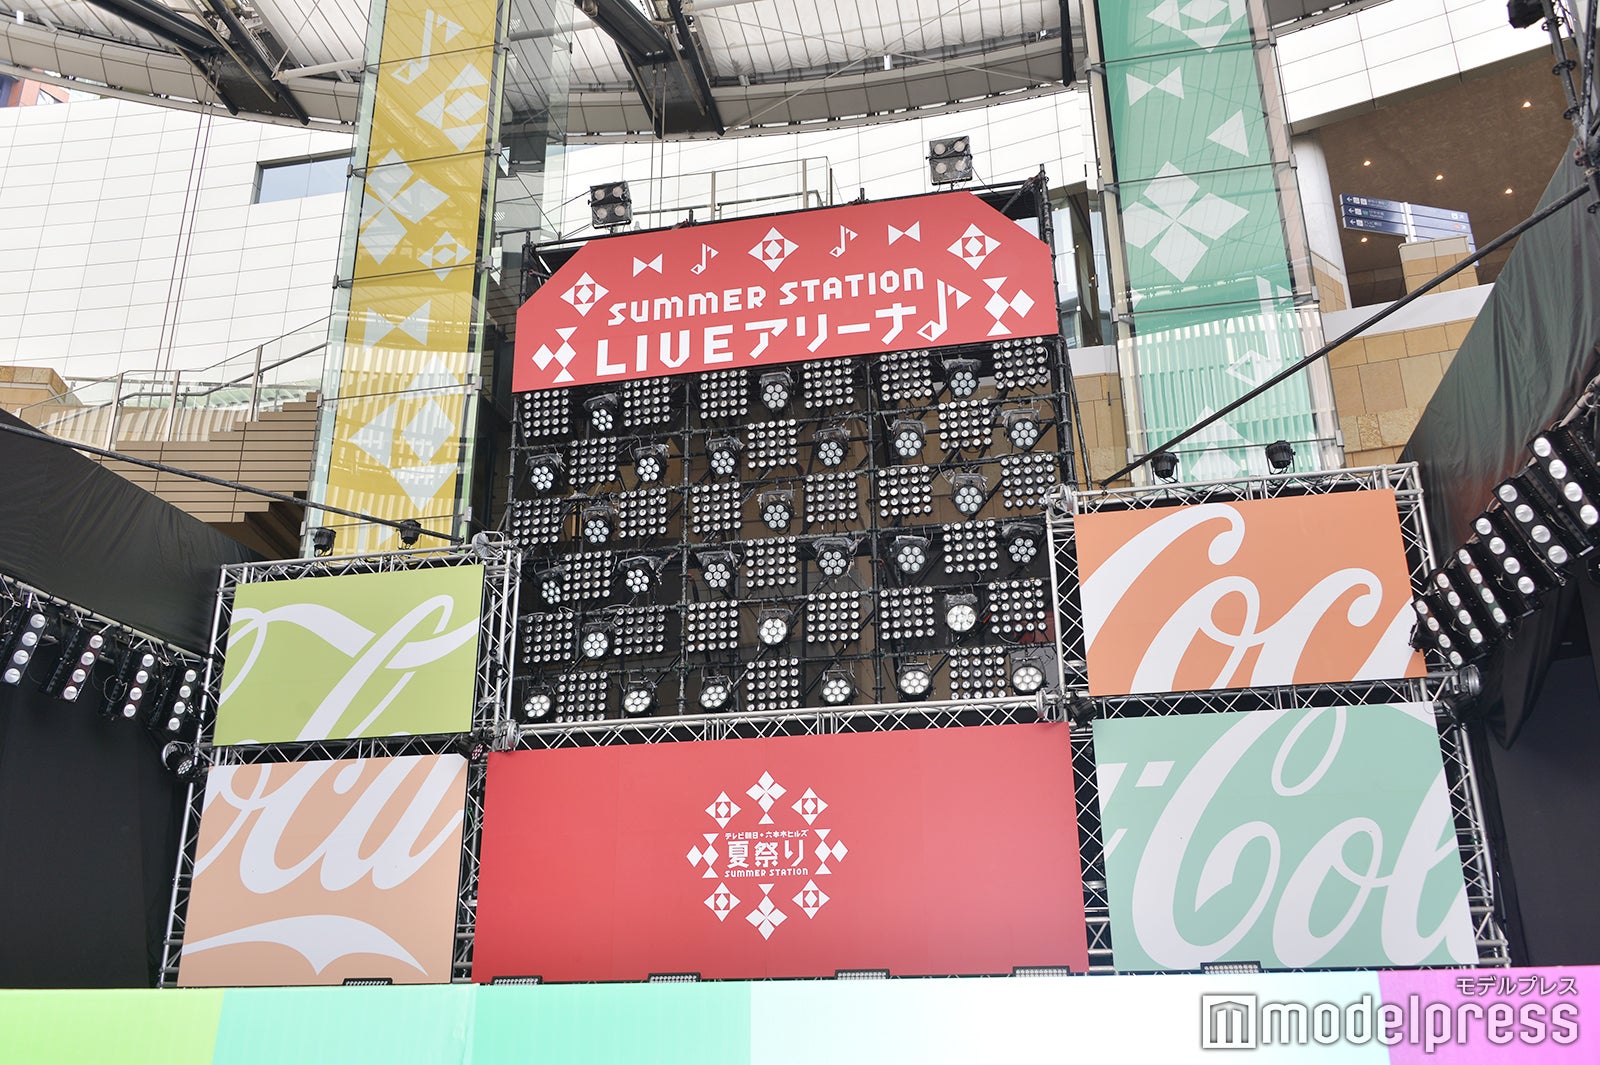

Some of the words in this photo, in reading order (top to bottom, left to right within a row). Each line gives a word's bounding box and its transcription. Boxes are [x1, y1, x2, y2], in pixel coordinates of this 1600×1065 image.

[608, 285, 766, 327] SUMMER
[779, 267, 924, 306] STATION
[597, 325, 734, 376] LIVE
[724, 869, 767, 878] SUMMER
[769, 867, 809, 877] STATION
[727, 839, 804, 869] 夏祭り
